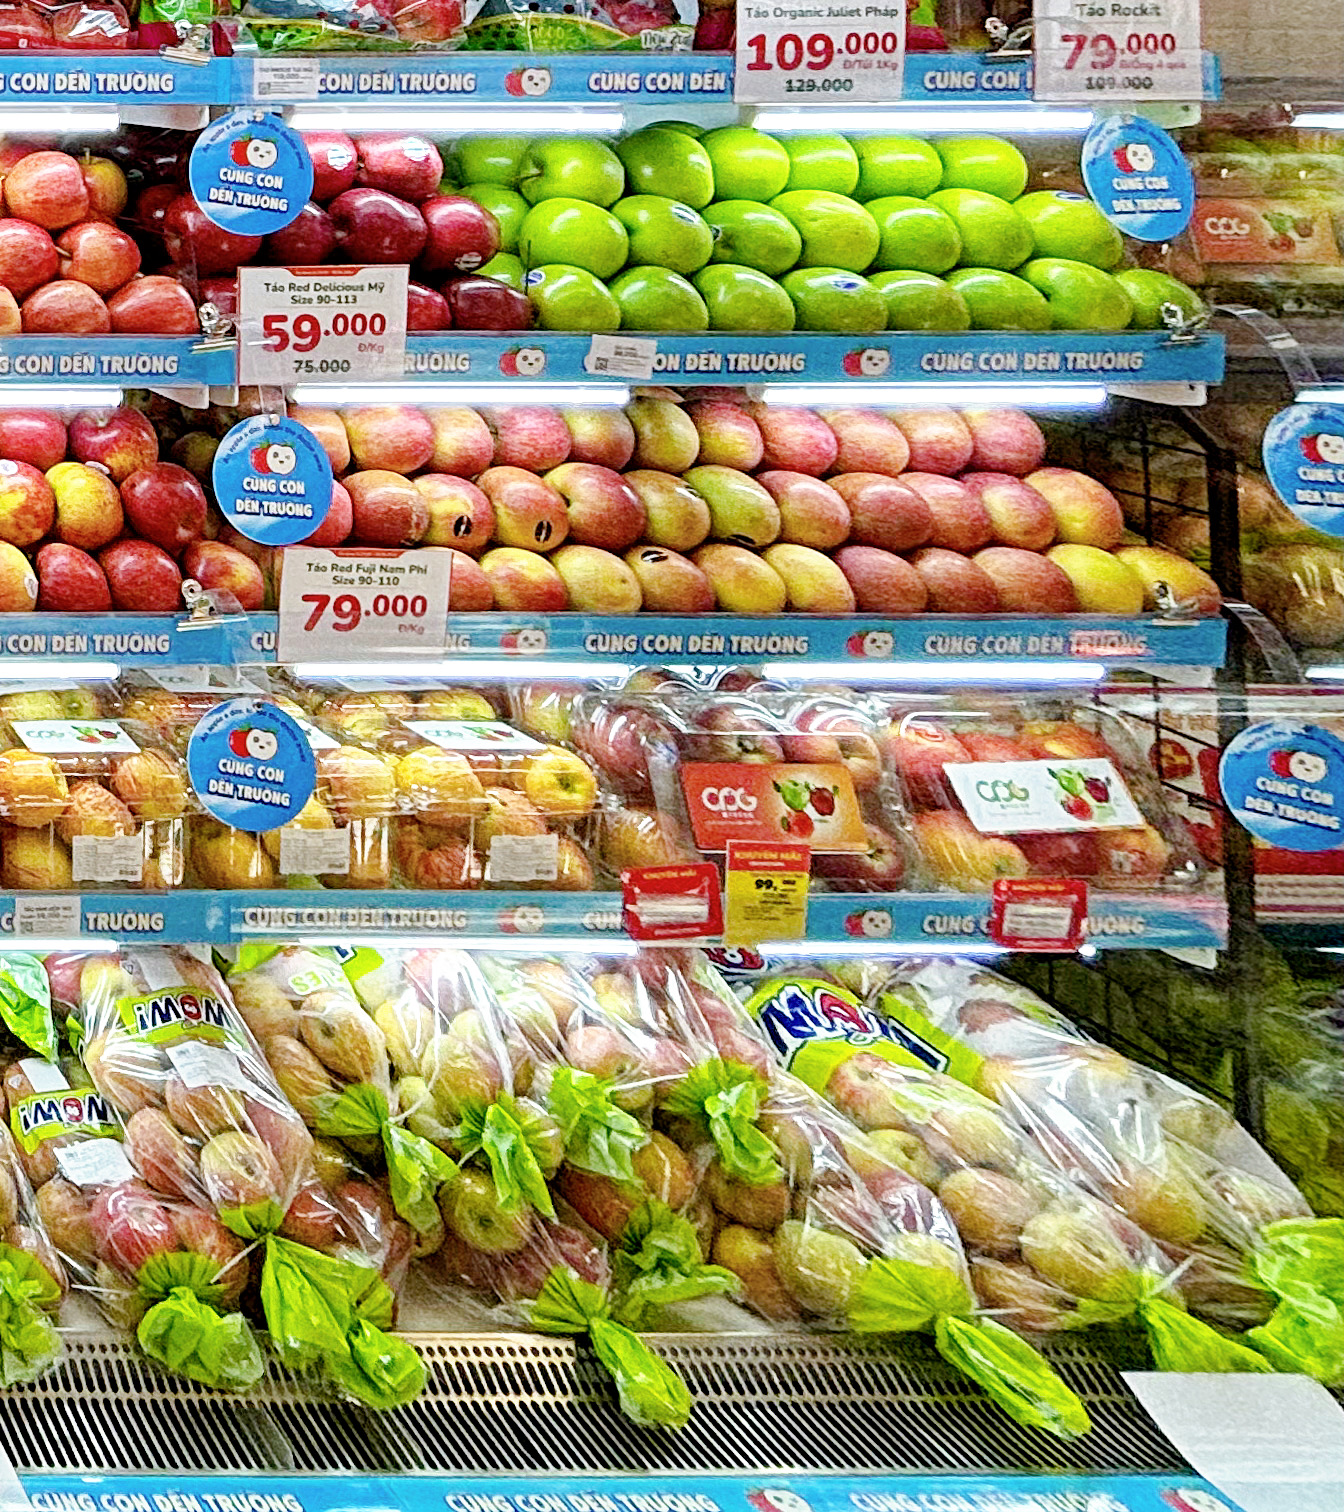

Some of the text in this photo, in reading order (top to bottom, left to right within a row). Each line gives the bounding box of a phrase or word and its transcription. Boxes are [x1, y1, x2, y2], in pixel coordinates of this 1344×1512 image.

[745, 6, 898, 20] Táo Organic Juliet Pháp
[1075, 2, 1162, 17] Táo Rockit
[747, 32, 897, 71] 109.000
[1060, 33, 1176, 70] 79.000
[10, 72, 50, 92] CON
[785, 79, 853, 93] 129.000
[264, 282, 385, 294] Táo Red Delicious Mỹ
[291, 295, 357, 305] Size 90-113
[263, 313, 386, 353] 59.000
[294, 360, 351, 373] 75.000
[306, 563, 327, 573] Táo
[330, 563, 353, 573] Red
[356, 564, 376, 575] Fuji
[379, 565, 405, 574] Nam
[332, 576, 400, 586] Size 90-110
[301, 594, 428, 632] 79.000
